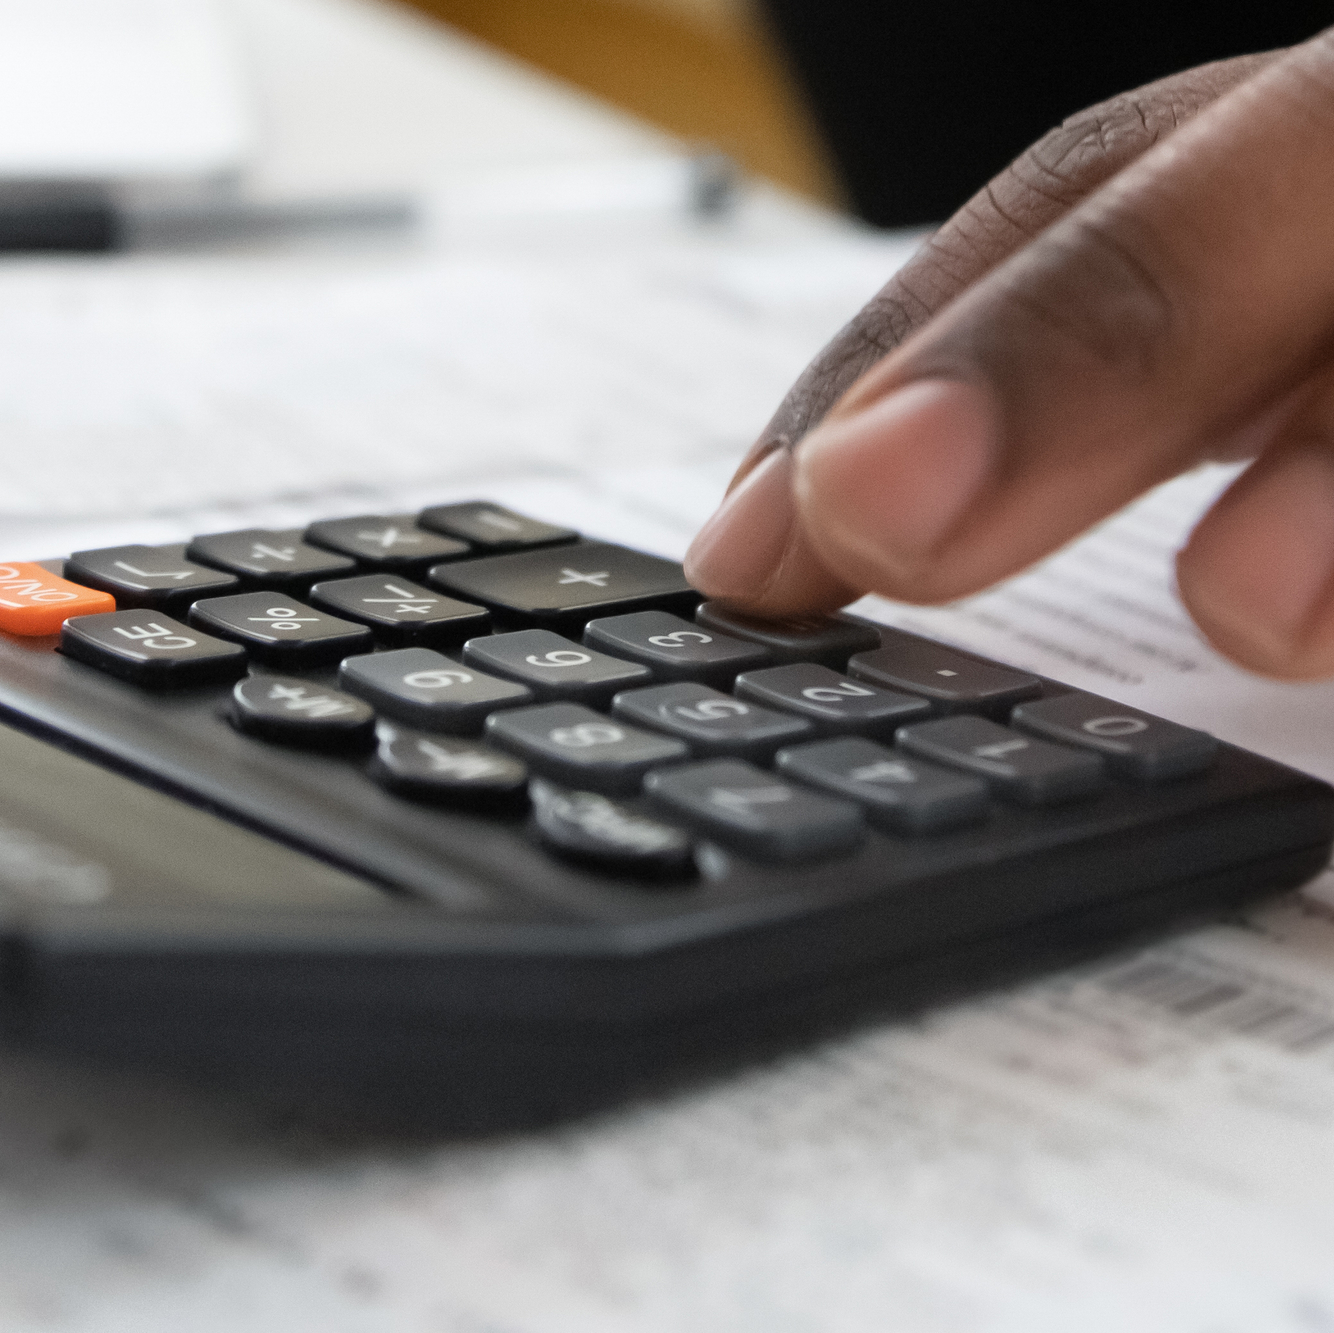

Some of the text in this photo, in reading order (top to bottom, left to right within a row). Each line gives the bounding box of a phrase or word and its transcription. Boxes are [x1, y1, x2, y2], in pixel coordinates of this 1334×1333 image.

[559, 568, 609, 587] +
[247, 607, 320, 631] %
[113, 622, 197, 651] CE
[648, 631, 713, 647] 3
[525, 650, 592, 667] 6
[403, 669, 474, 689] 9
[801, 682, 876, 702] 2
[675, 699, 749, 720] 5
[550, 722, 625, 747] 8
[1081, 716, 1149, 736] 0
[974, 738, 1030, 760] 1
[852, 760, 918, 784] 4
[710, 784, 793, 814] 7
